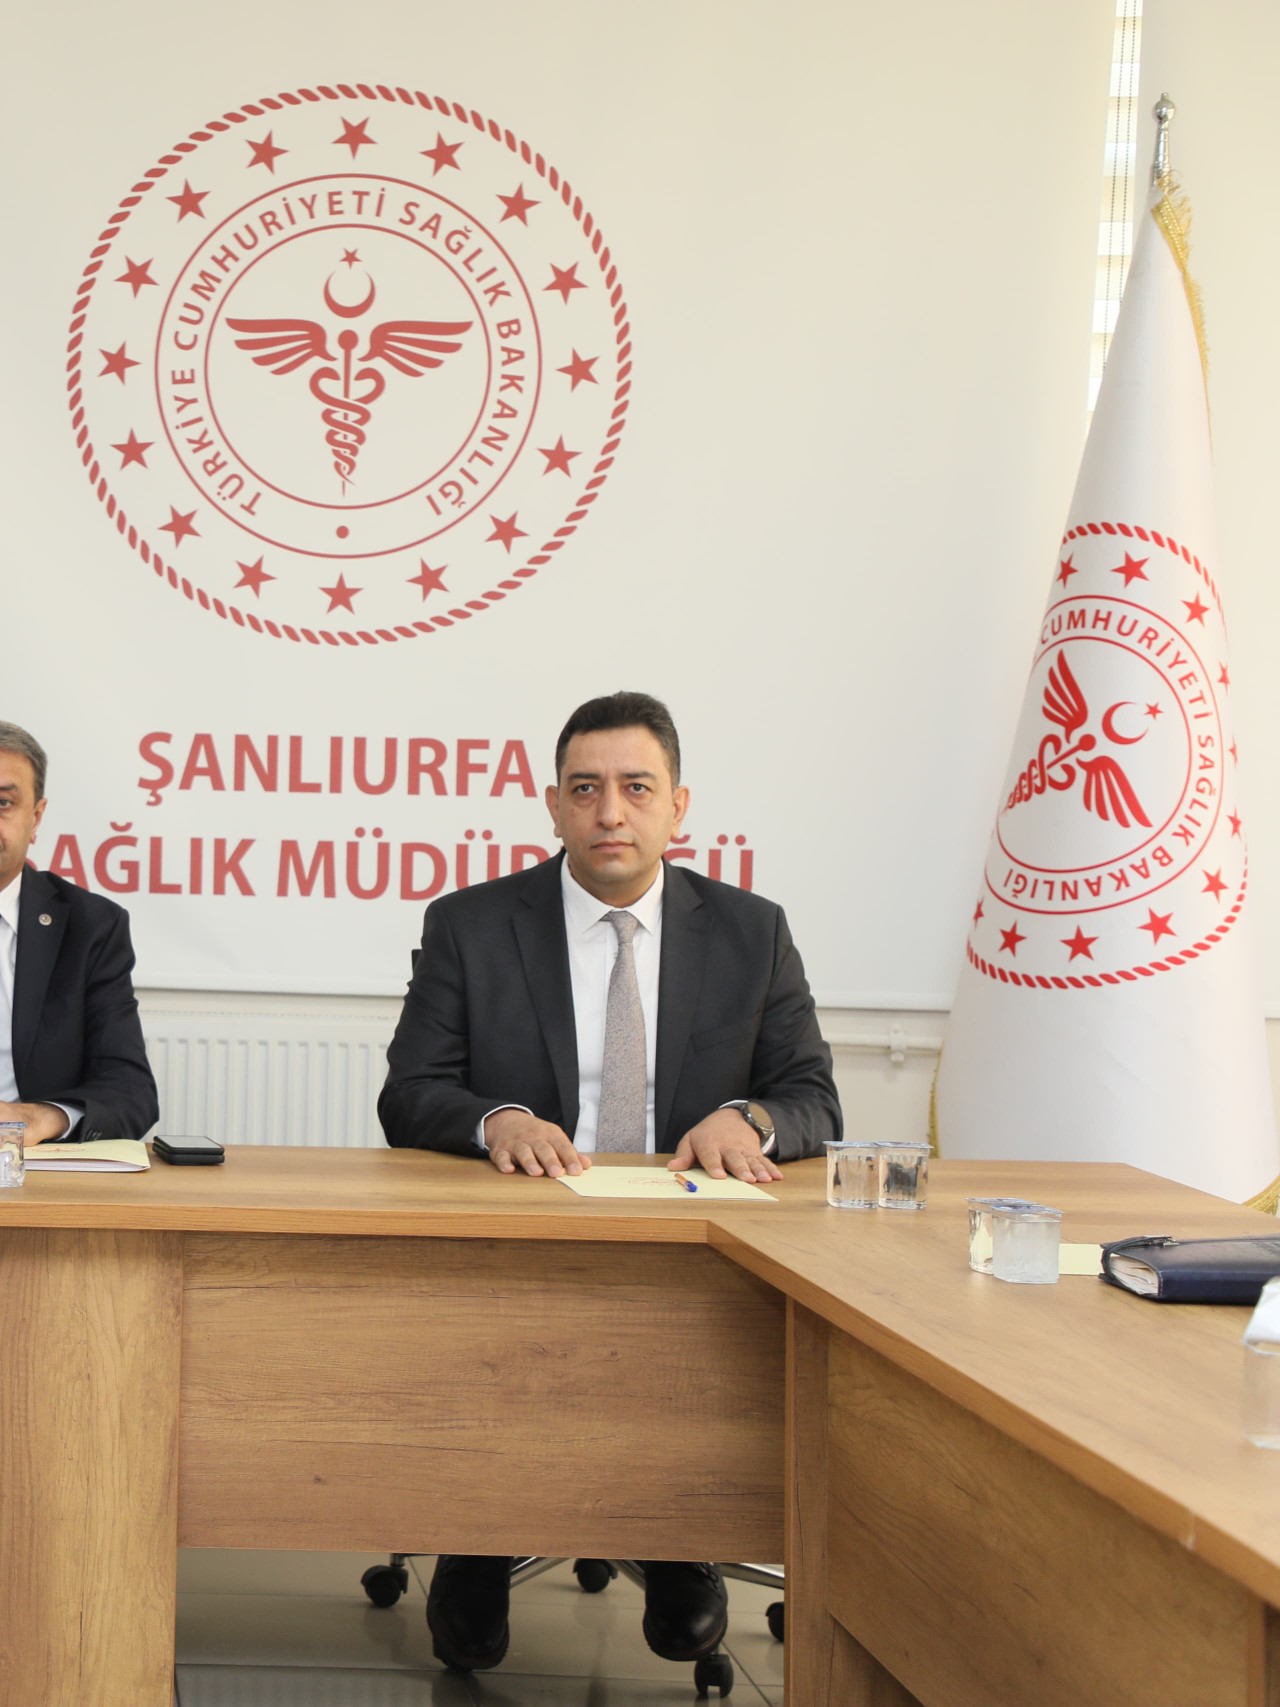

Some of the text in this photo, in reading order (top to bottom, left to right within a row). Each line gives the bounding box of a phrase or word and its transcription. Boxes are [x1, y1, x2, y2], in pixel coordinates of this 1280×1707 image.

[171, 187, 526, 516] TÜRKİYE CUMHURİYETİ SAĞLIK BAKANLIĞI
[138, 731, 538, 807] ŞANLIURFA
[1003, 608, 1217, 901] CUMHURİYETİ SAĞLIK BAKANLIĞI
[26, 821, 256, 897] AĞLIK
